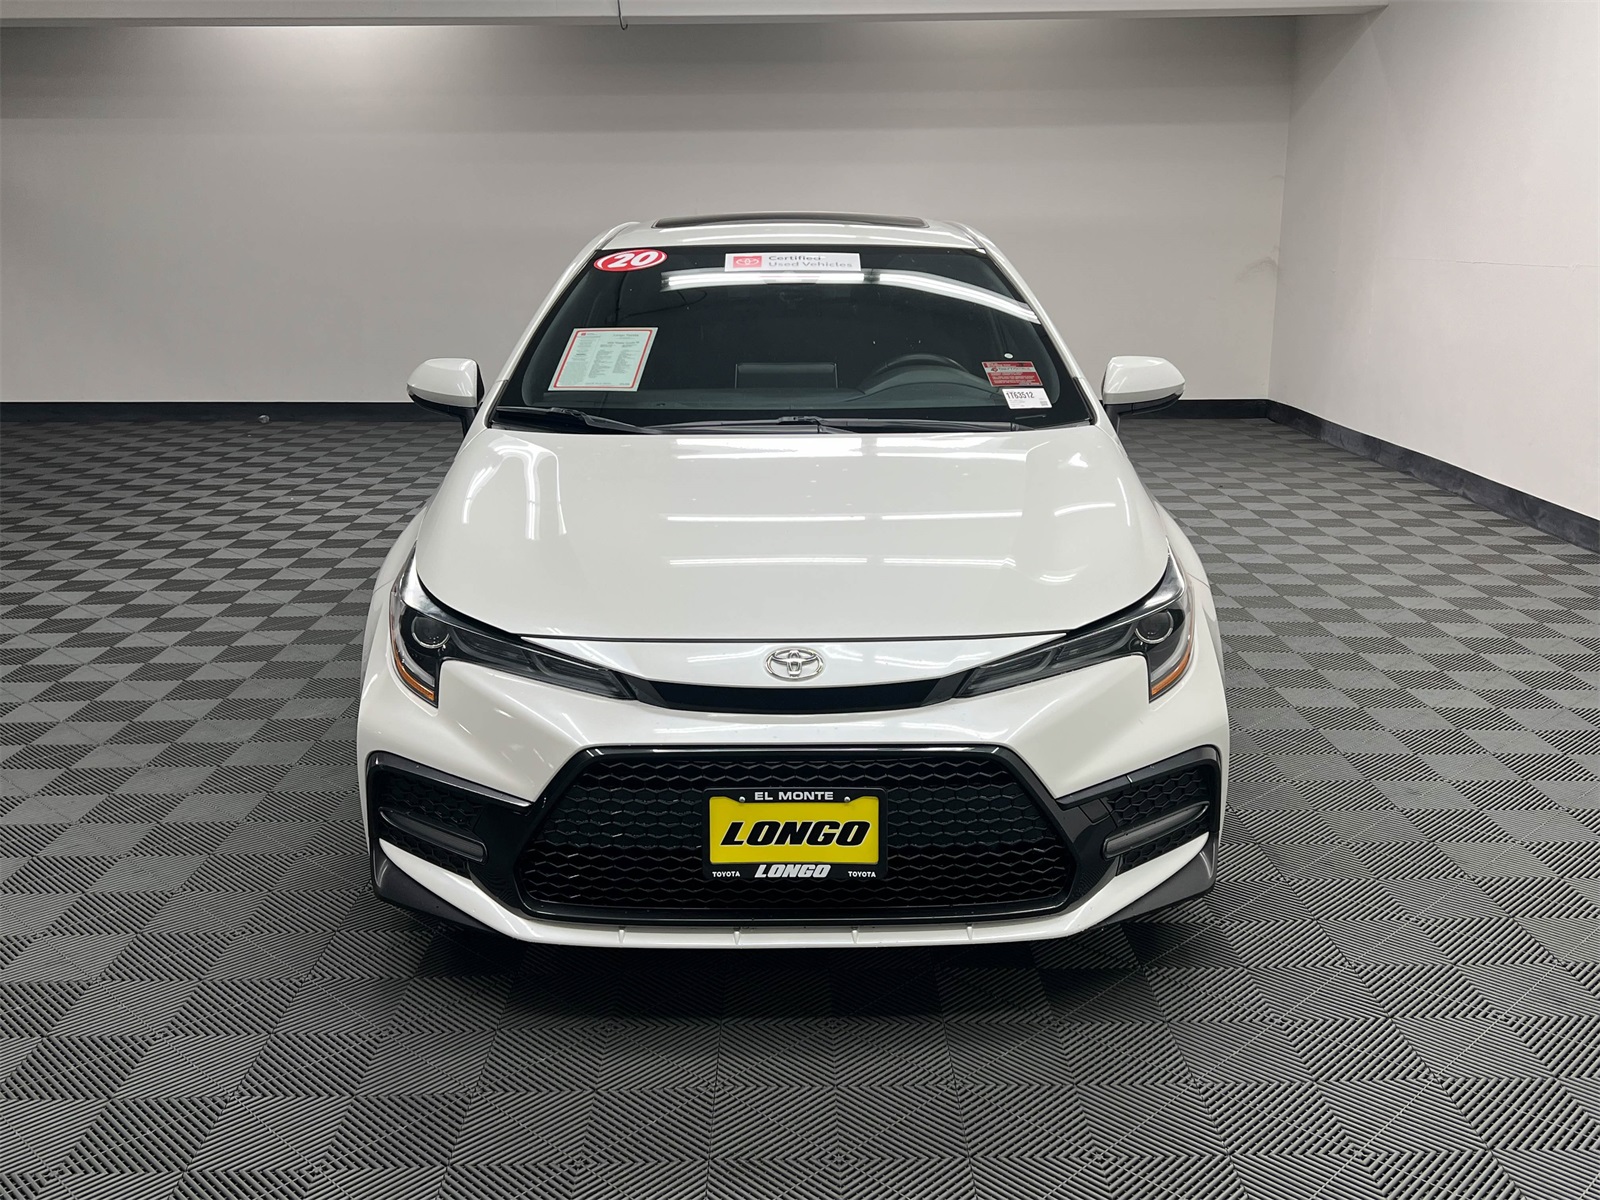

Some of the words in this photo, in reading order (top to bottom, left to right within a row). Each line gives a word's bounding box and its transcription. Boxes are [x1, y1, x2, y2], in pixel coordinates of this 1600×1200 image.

[607, 251, 659, 268] 20
[1006, 391, 1035, 400] 1T63512
[754, 791, 774, 801] EL
[778, 791, 834, 801] MONTE
[720, 820, 871, 847] LONGO
[712, 870, 741, 878] TOYOTA
[754, 864, 832, 878] LONGO
[847, 870, 877, 878] TOYOTA
